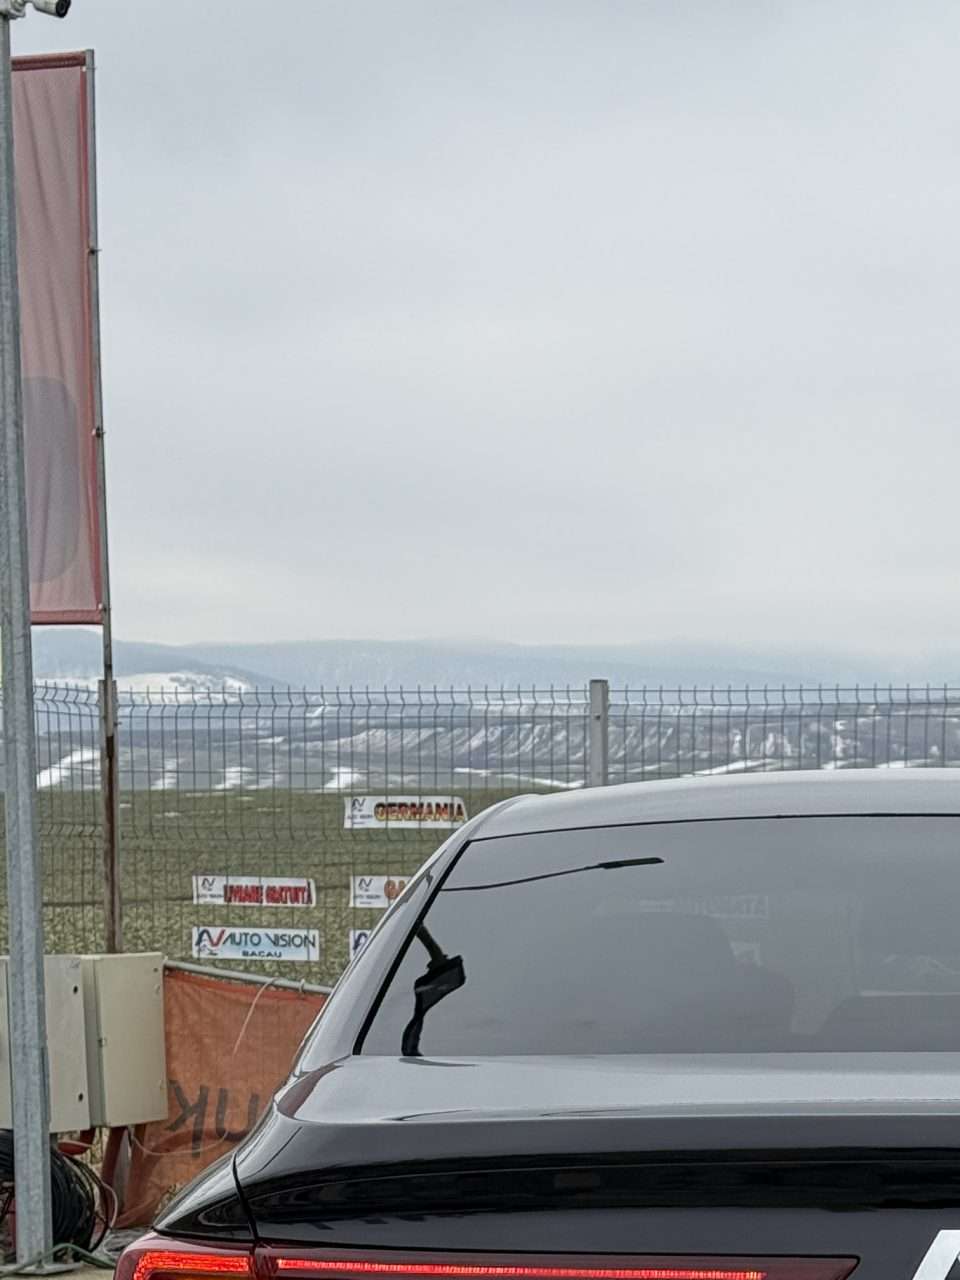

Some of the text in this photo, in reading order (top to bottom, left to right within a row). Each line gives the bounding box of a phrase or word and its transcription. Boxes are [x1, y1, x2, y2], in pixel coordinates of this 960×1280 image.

[374, 802, 464, 821] GERMANIA
[223, 932, 262, 947] AUTO
[264, 933, 316, 949] VISION
